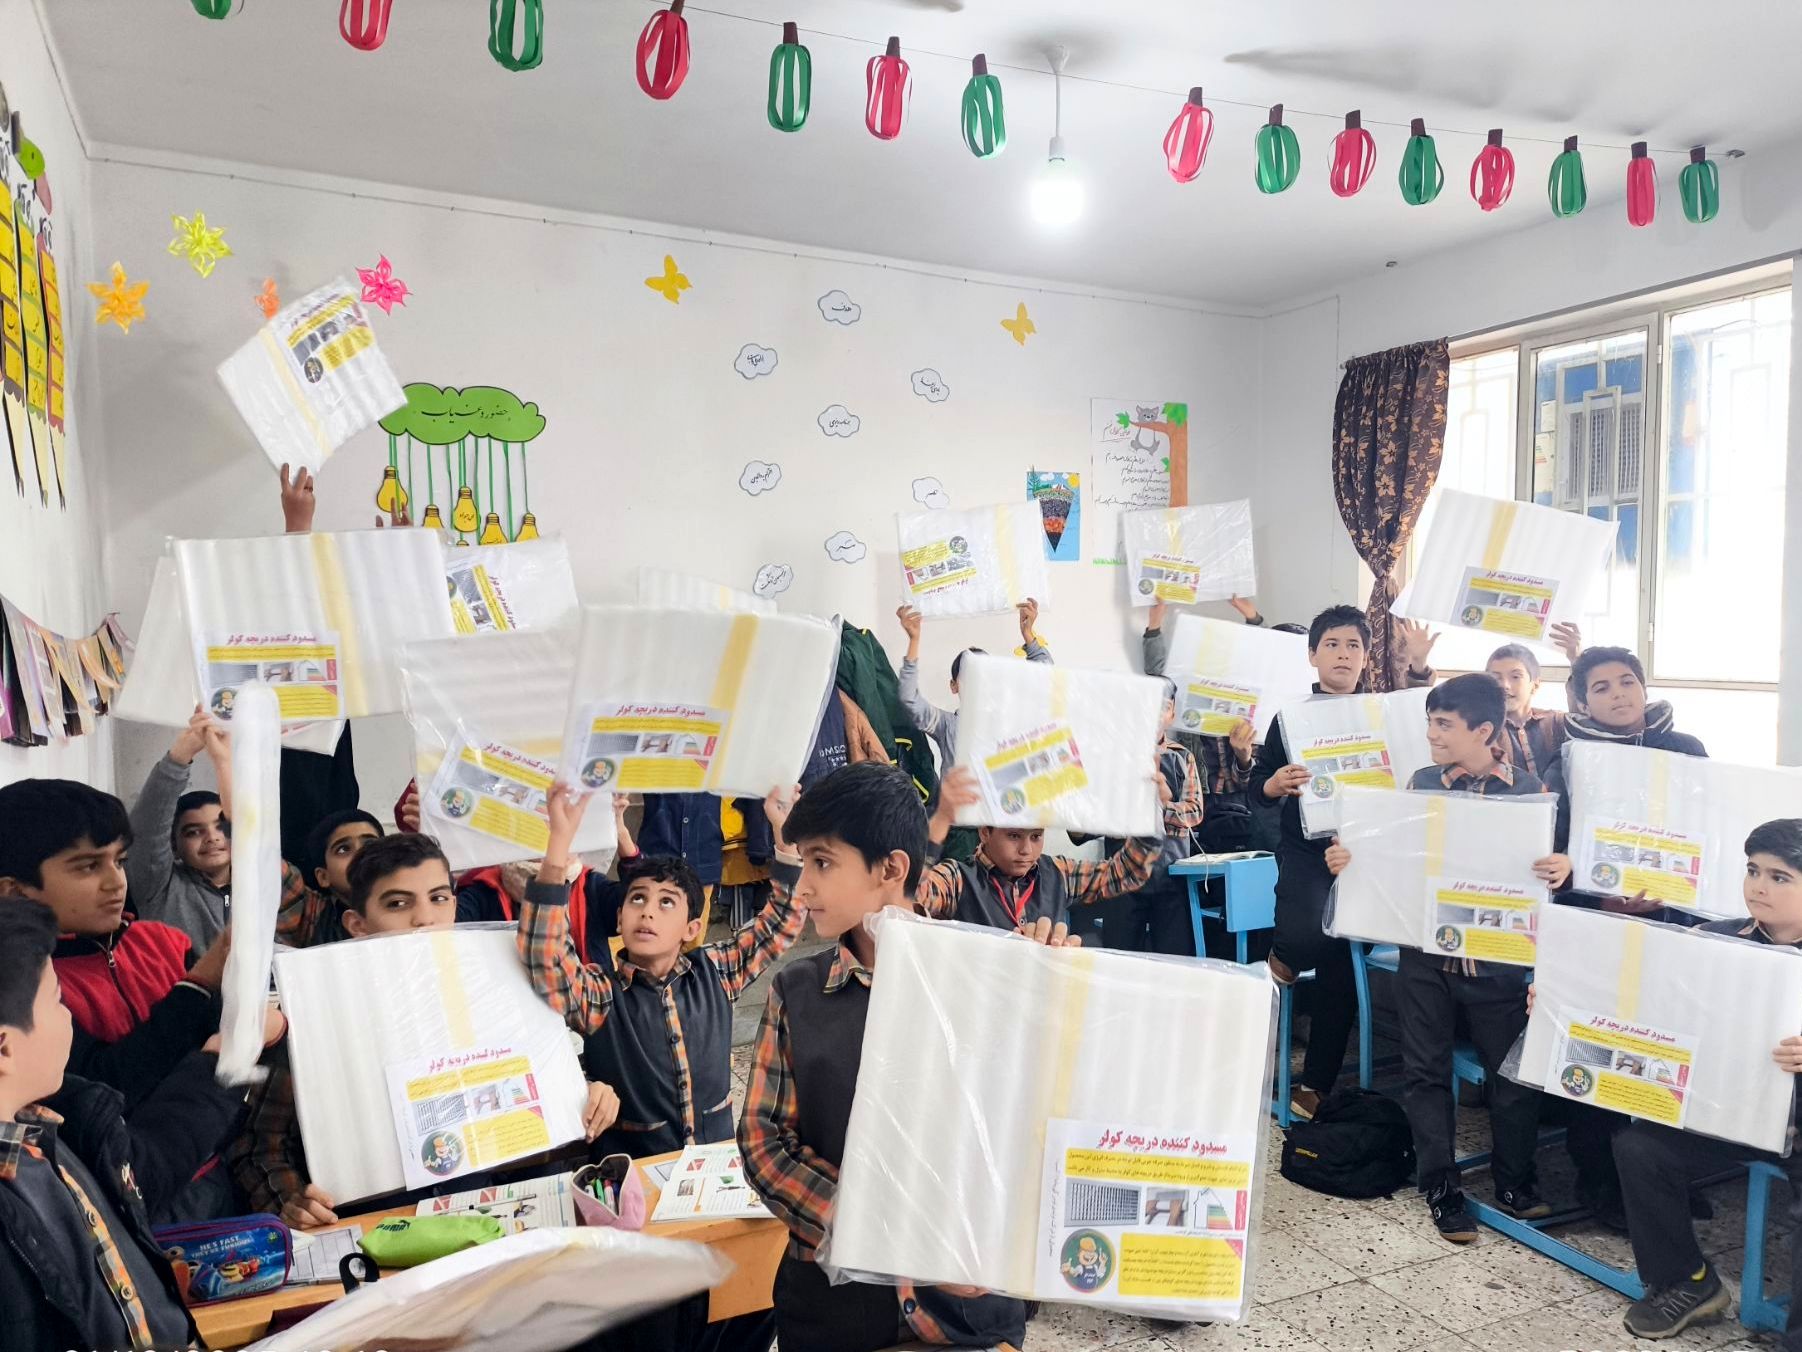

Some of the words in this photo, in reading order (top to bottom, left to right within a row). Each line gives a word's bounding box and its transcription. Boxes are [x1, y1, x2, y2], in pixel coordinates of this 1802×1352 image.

[420, 404, 481, 424] غیاب
[484, 405, 509, 419] حضور
[616, 704, 634, 717] کولر
[635, 705, 658, 716] دریچه
[658, 706, 681, 715] کننده
[680, 707, 706, 718] مسدود
[1589, 1015, 1607, 1026] کولر
[1607, 1021, 1630, 1032] دریچه
[1629, 1026, 1651, 1037] کننده
[1651, 1030, 1676, 1042] مسدود
[489, 1046, 512, 1060] مسدود
[427, 1057, 446, 1073] کولر
[1096, 1128, 1123, 1150] کولر
[1125, 1133, 1158, 1153] دریچه
[1159, 1135, 1191, 1152] کننده
[1192, 1140, 1228, 1156] مسدود
[219, 1234, 240, 1247] FAST
